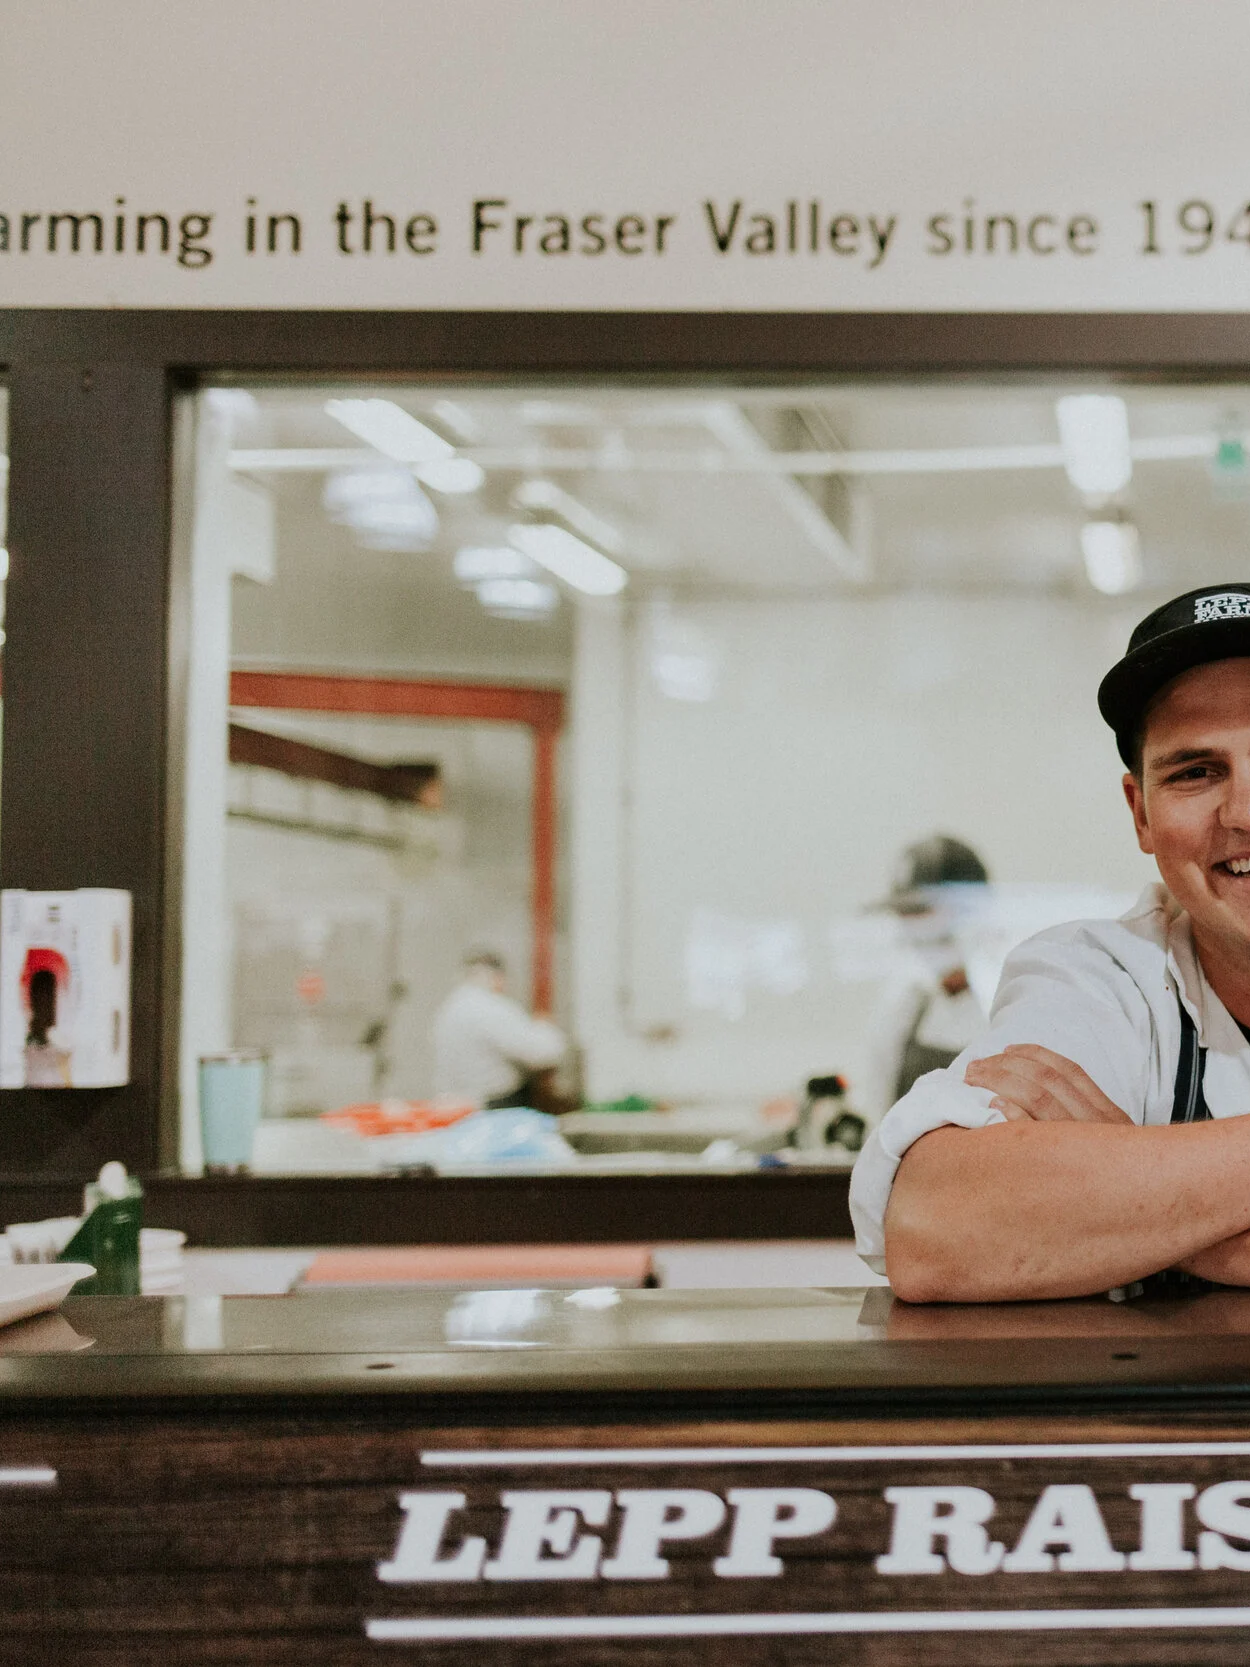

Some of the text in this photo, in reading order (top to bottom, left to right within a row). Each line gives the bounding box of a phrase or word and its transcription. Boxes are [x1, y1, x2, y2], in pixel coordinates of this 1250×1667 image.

[245, 198, 301, 253] in
[335, 200, 438, 254] the
[471, 200, 677, 254] Fraser
[705, 200, 896, 268] Valley
[926, 198, 1097, 255] since
[376, 1488, 838, 1583] LEPP
